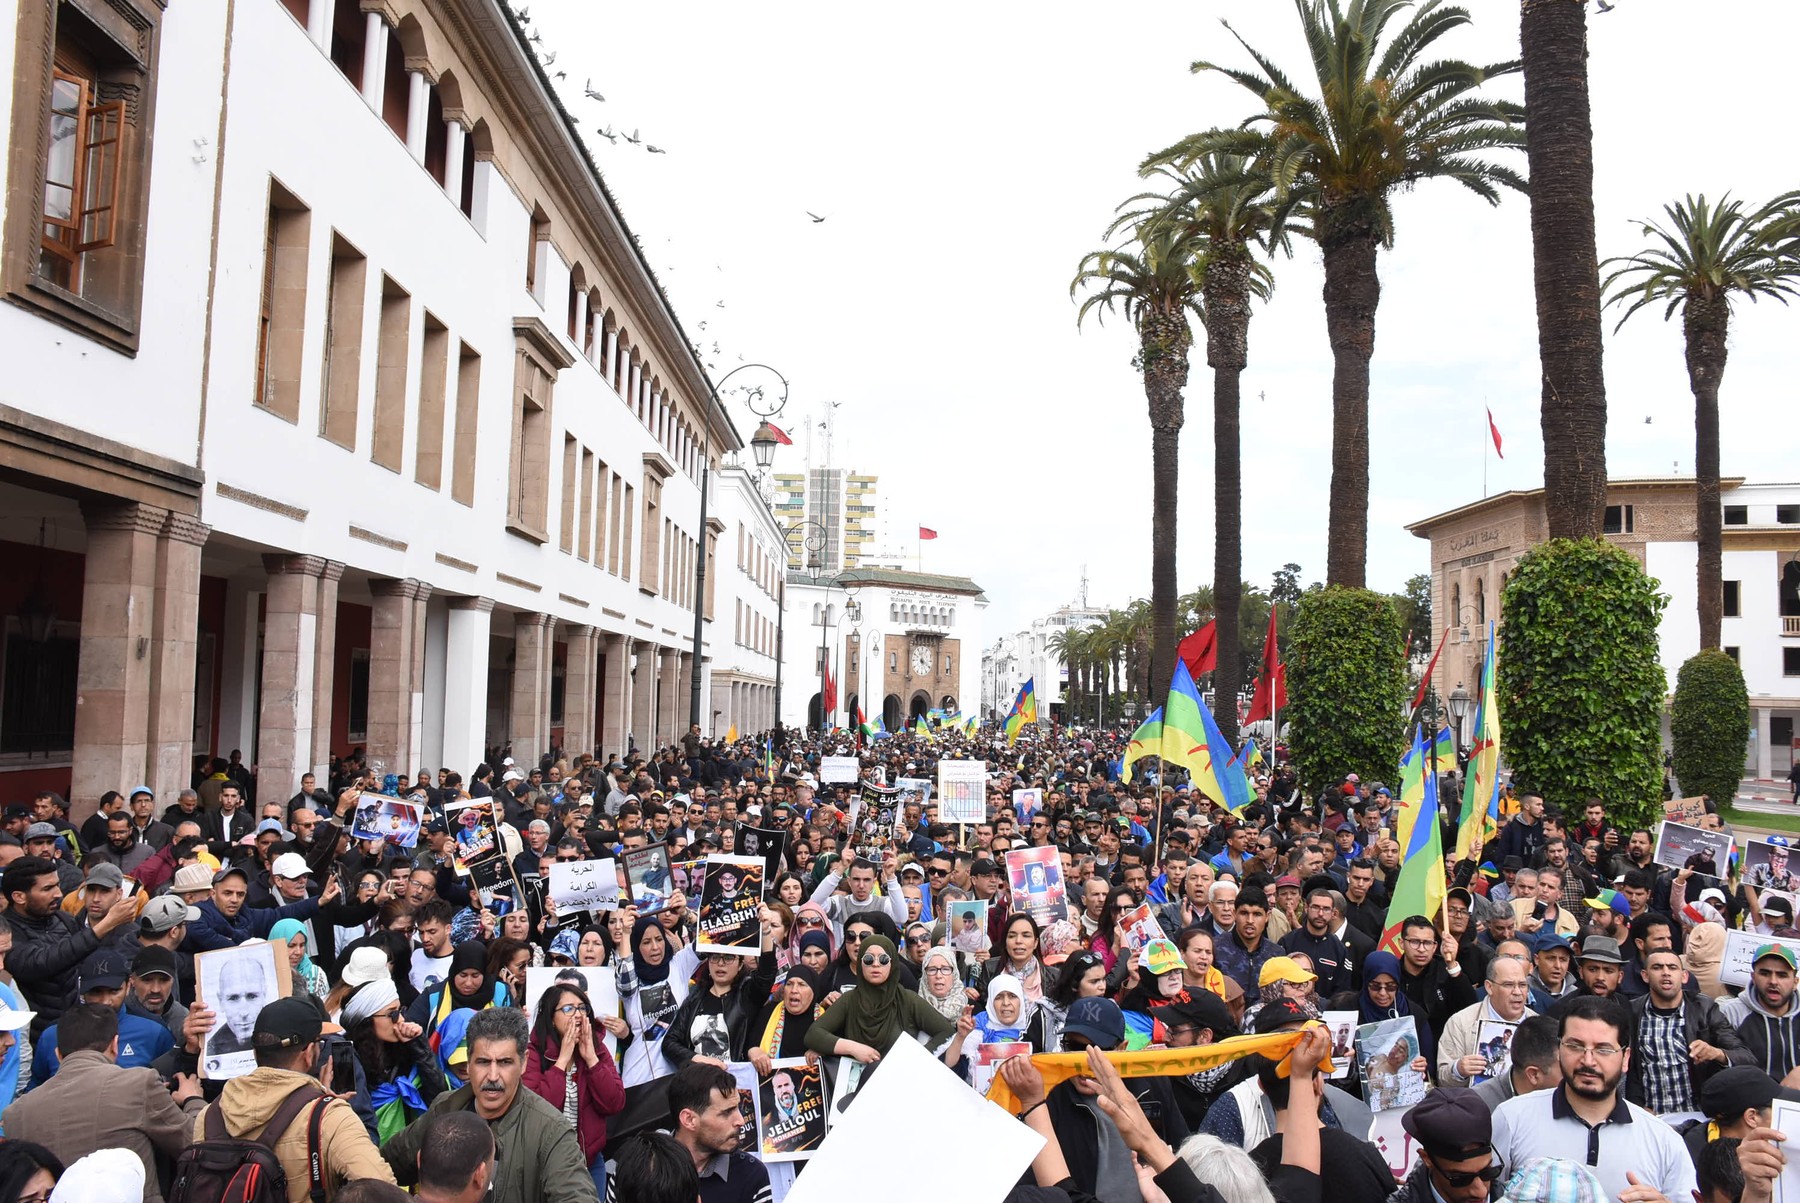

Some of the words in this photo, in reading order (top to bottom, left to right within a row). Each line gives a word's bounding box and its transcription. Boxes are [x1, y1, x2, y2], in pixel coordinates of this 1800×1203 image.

[571, 863, 595, 875] الحرية
[478, 878, 515, 894] #freedom
[570, 881, 598, 893] الكرامة
[556, 898, 594, 910] الاجتماعي
[734, 895, 760, 911] FREE
[708, 922, 741, 935] MOHAMED
[643, 1003, 679, 1020] #freedom
[1080, 1001, 1102, 1022] NY
[797, 1095, 823, 1113] FREE
[768, 1108, 821, 1138] JELLOUL
[771, 1124, 807, 1143] MOHAMED
[312, 1152, 320, 1181] Canon
